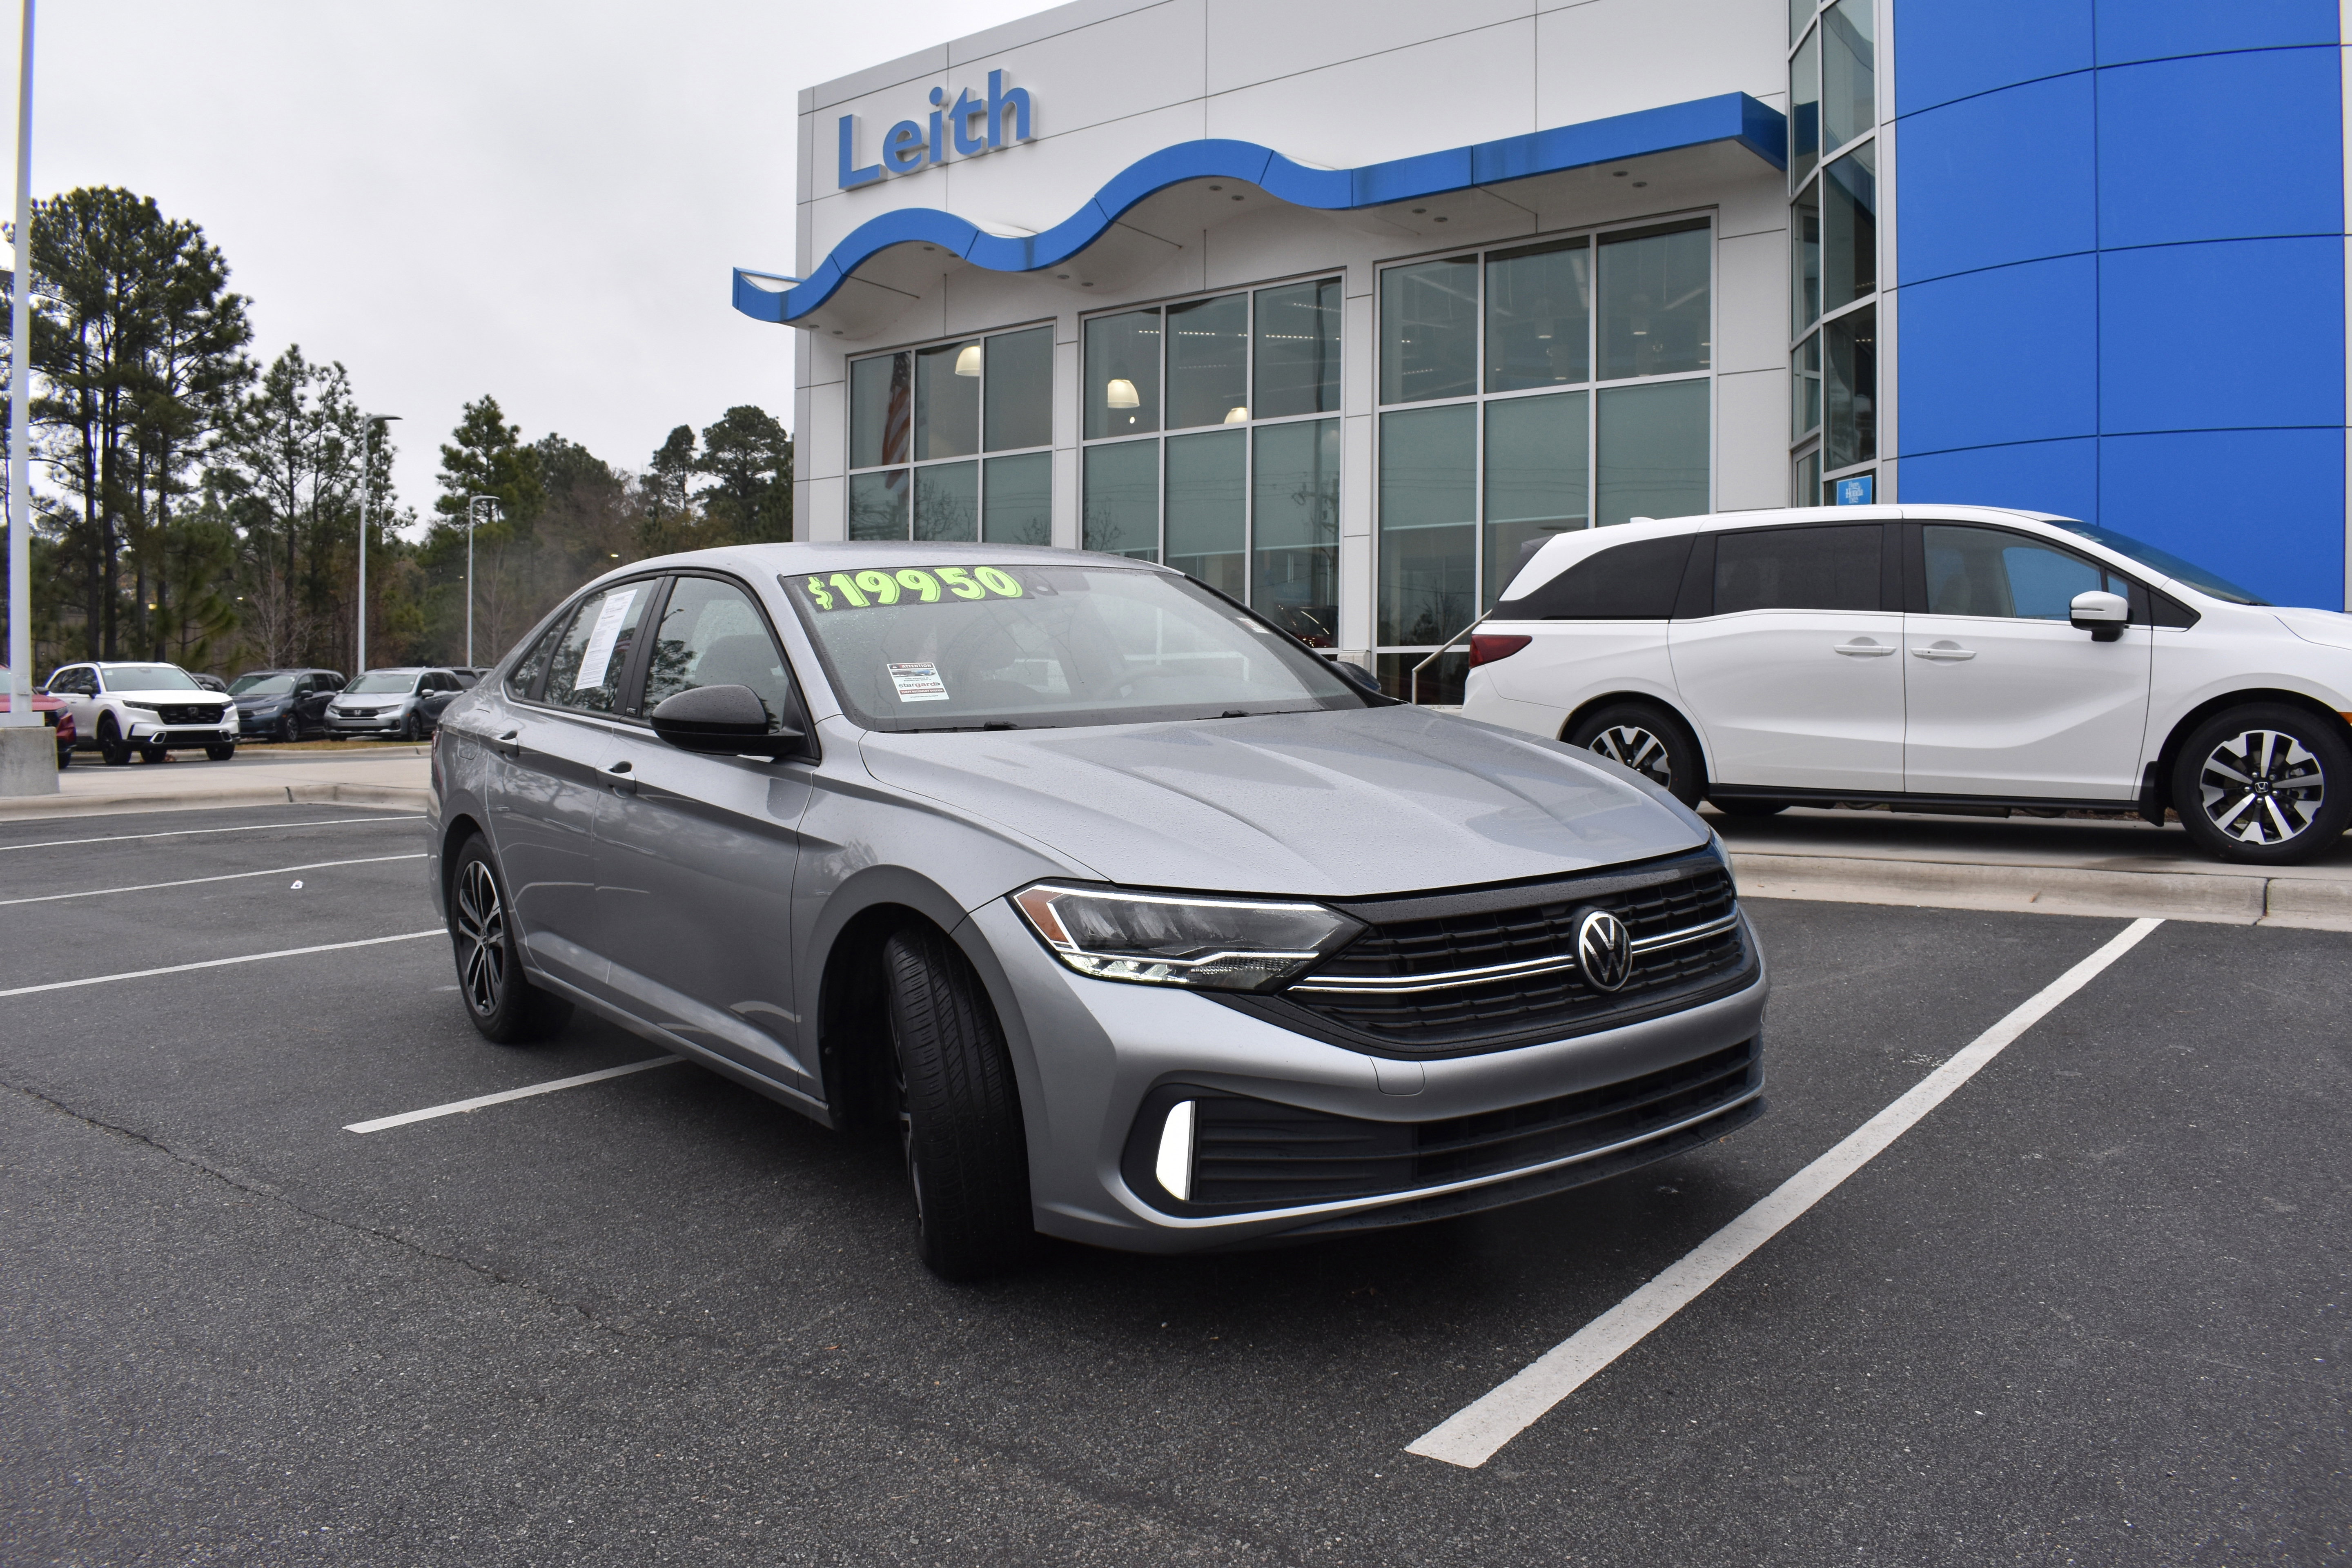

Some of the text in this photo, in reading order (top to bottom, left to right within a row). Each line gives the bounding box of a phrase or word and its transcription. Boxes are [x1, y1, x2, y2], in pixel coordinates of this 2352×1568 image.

[839, 69, 1035, 190] Leith
[1846, 488, 1863, 498] Honda
[808, 567, 1022, 610] $19950
